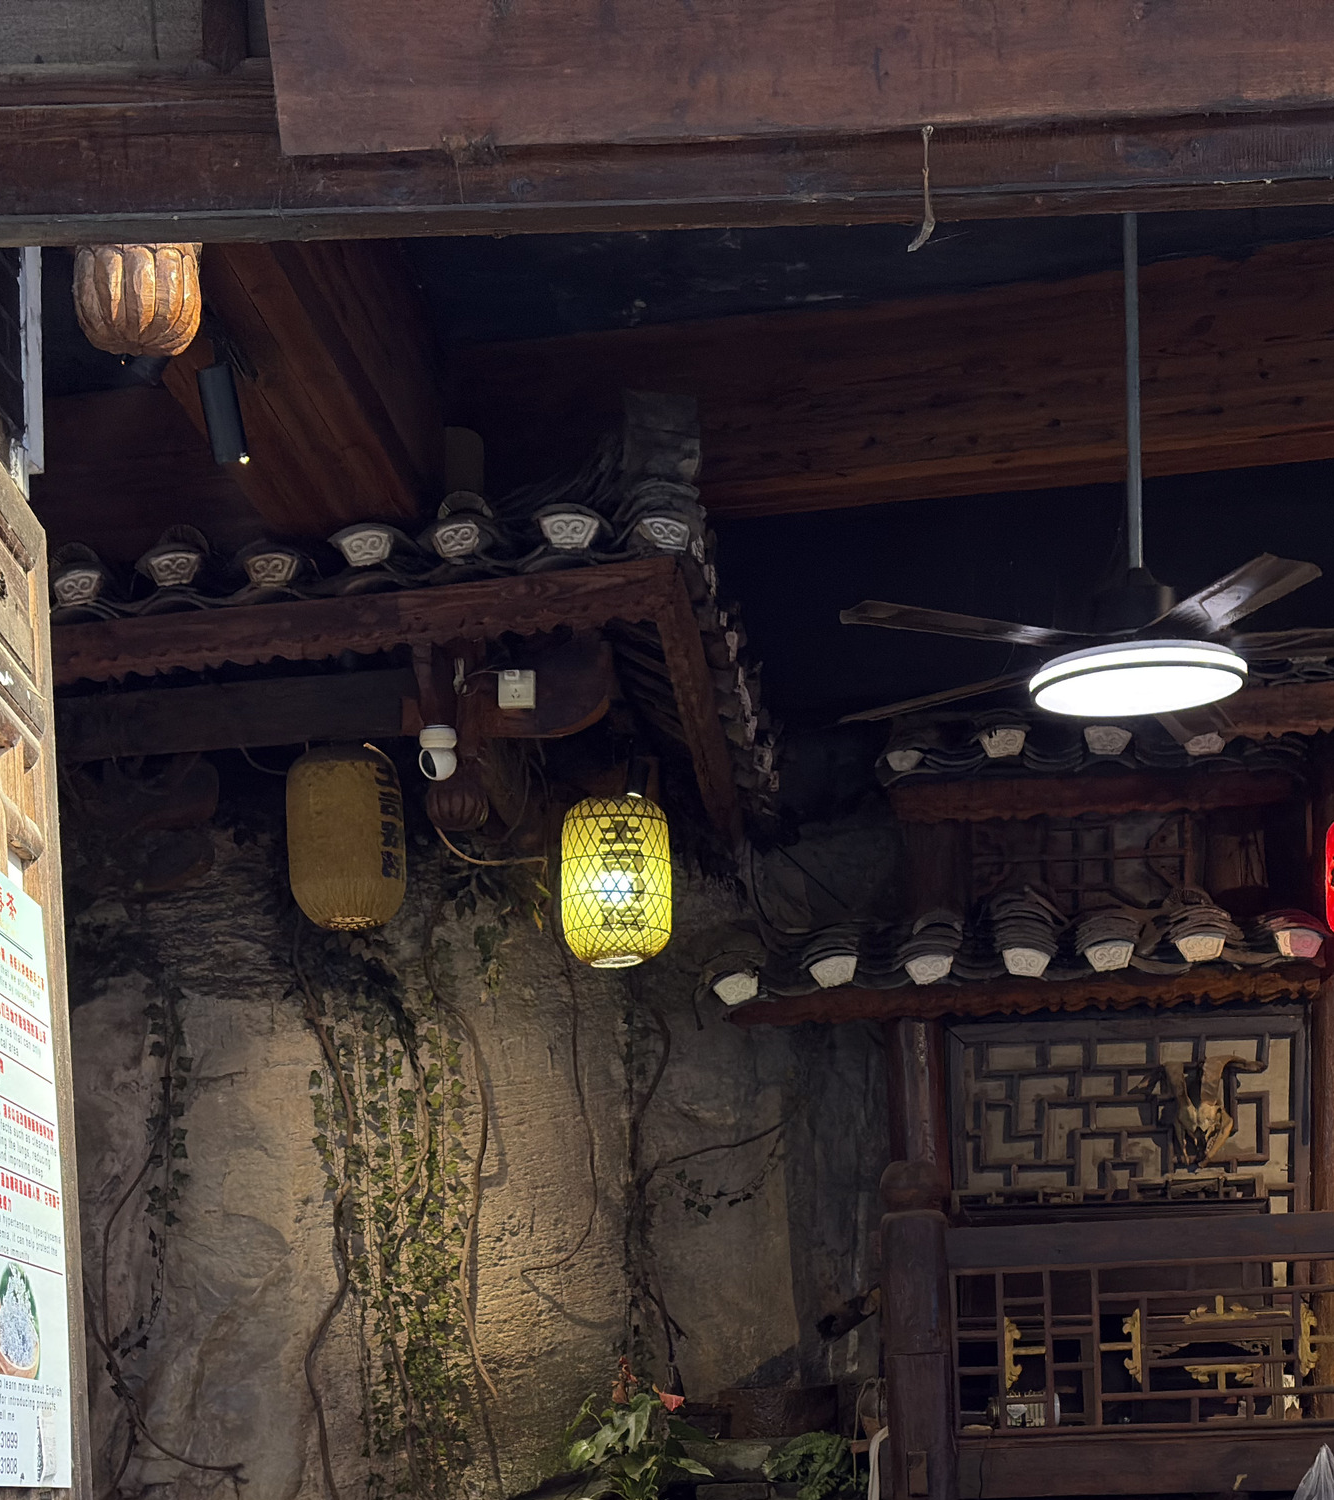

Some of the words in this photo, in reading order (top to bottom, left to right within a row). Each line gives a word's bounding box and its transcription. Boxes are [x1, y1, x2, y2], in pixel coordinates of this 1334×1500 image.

[3, 1378, 17, 1392] learn
[17, 1380, 30, 1394] more
[30, 1383, 45, 1396] about
[45, 1385, 62, 1401] English
